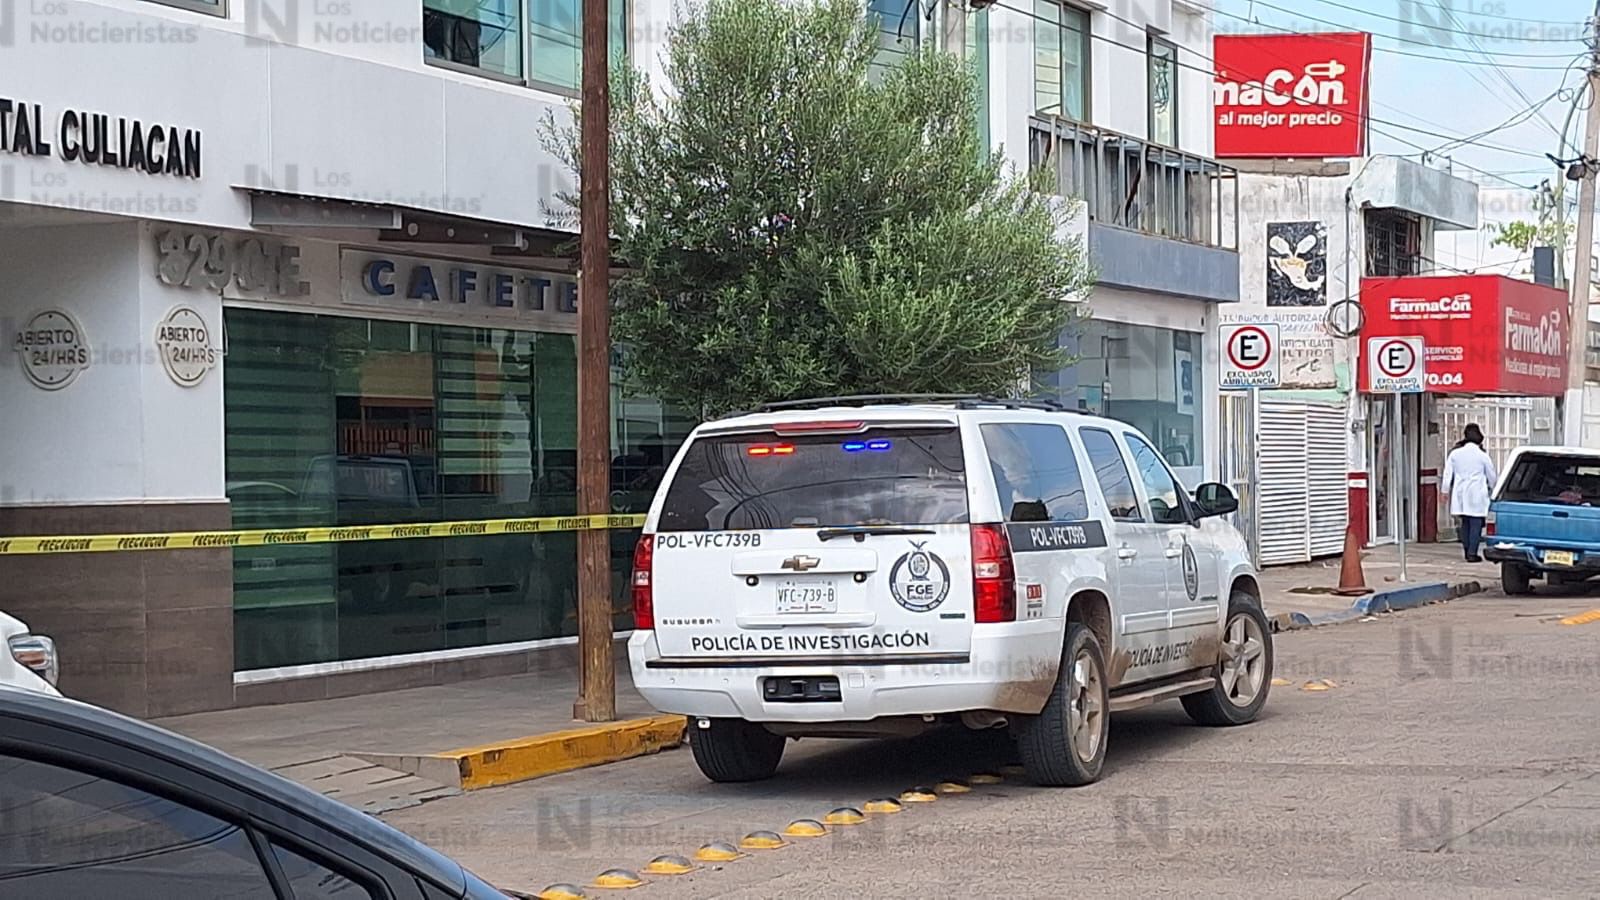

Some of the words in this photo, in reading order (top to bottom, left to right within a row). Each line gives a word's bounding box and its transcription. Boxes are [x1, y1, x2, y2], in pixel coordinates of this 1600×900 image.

[1219, 111, 1233, 125] al
[1237, 111, 1285, 128] mejor
[1289, 111, 1342, 128] precio
[61, 109, 201, 178] CULIACAN
[16, 330, 74, 346] ABIERTO
[159, 326, 206, 343] ABIERTO
[1240, 335, 1259, 361] E
[1389, 347, 1405, 370] E
[657, 533, 761, 549] POL-VFC739B
[778, 588, 835, 603] VFC-739-B
[907, 584, 933, 595] FGE
[691, 633, 757, 651] POLICÍA
[761, 636, 785, 650] DE
[788, 630, 930, 650] INVESTIGACIÓN
